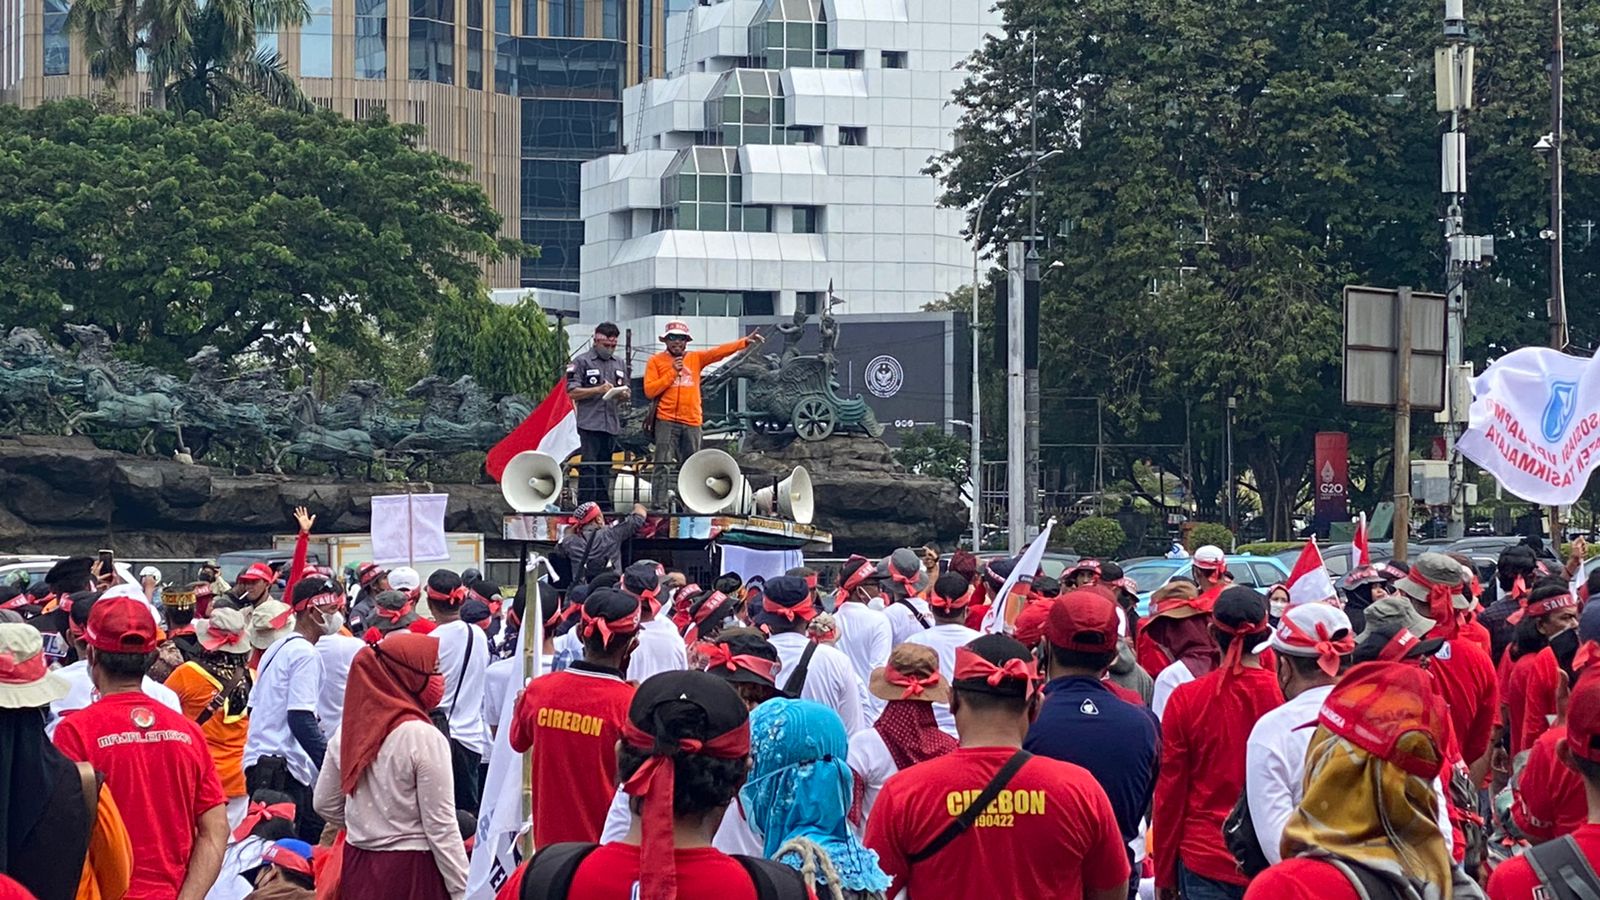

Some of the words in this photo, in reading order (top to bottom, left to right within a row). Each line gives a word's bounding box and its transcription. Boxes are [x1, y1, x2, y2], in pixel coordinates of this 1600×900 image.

[1320, 483, 1343, 493] G20
[537, 707, 603, 737] CIREBON
[975, 814, 1014, 827] 190422
